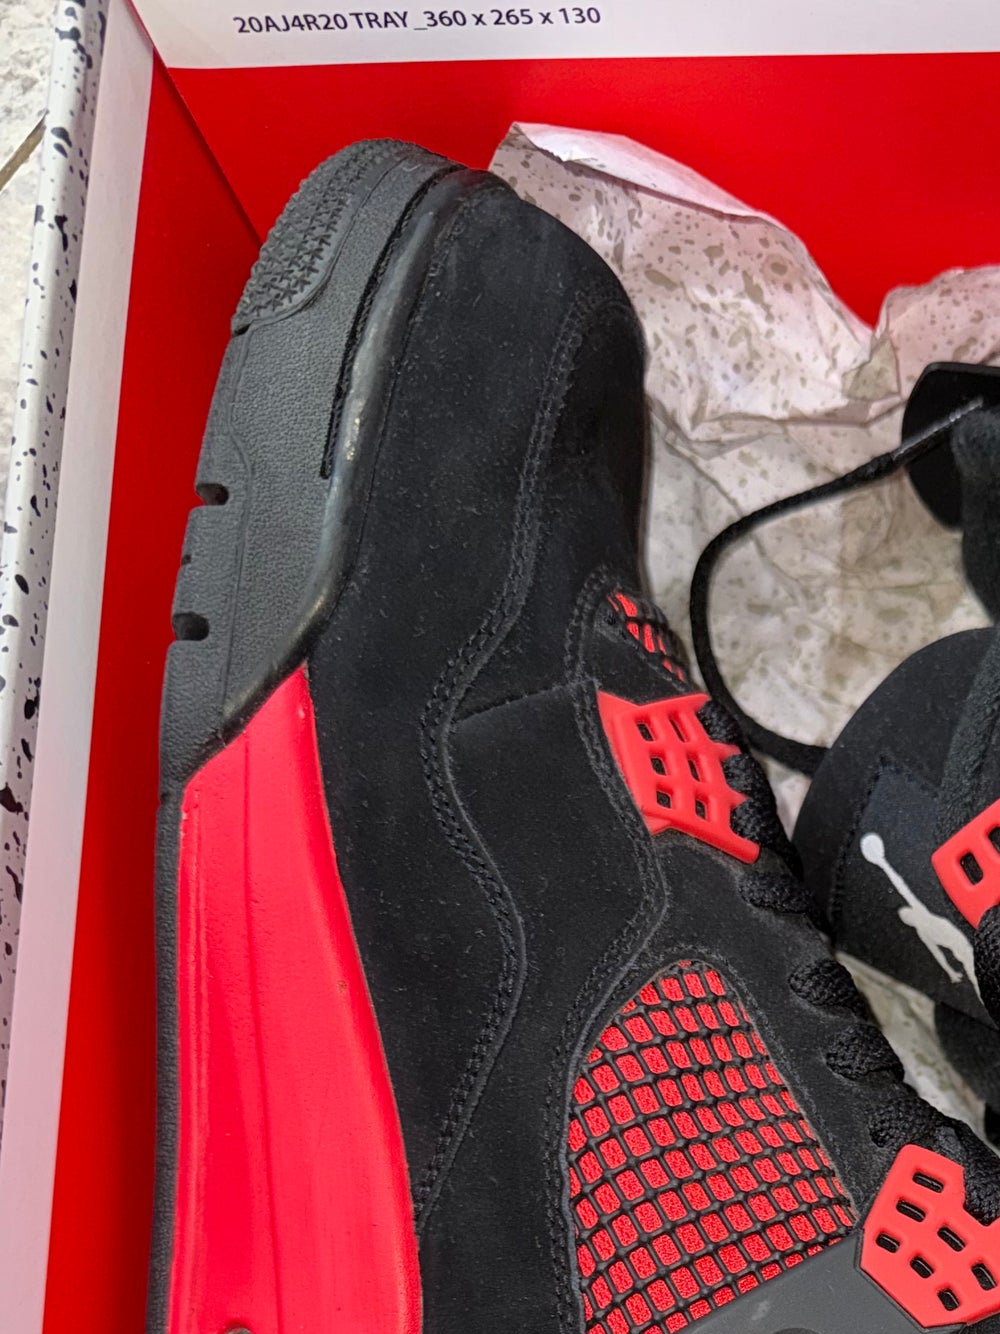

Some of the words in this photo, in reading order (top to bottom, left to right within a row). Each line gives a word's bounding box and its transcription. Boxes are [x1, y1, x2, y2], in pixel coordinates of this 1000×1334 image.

[232, 13, 348, 33] 20AJ4R20
[349, 11, 408, 29] TRAY
[471, 13, 487, 26] x
[490, 8, 534, 25] 265
[538, 12, 554, 24] x
[558, 7, 601, 24] 130
